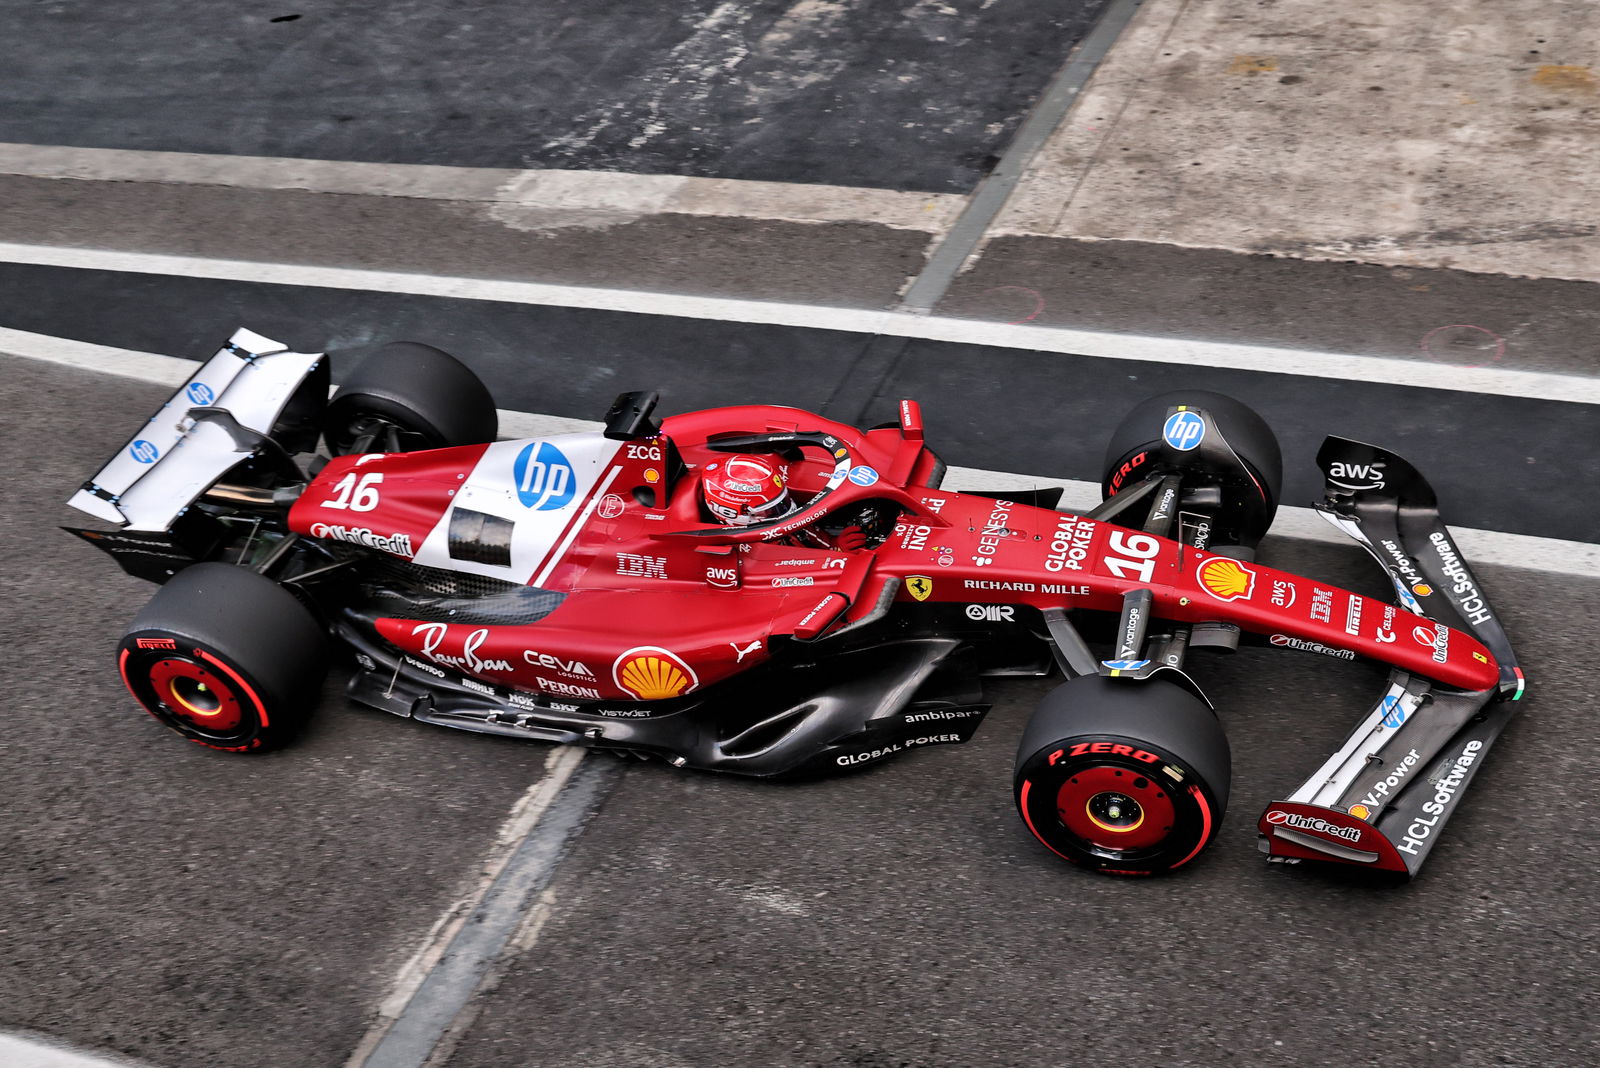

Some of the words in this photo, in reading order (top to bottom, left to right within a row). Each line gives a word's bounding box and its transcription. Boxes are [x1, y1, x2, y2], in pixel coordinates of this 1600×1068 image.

[187, 382, 213, 405] hp
[1165, 411, 1203, 450] hp
[131, 440, 158, 463] hp
[515, 442, 575, 511] hp
[849, 466, 878, 486] hp
[1329, 461, 1384, 481] aws
[321, 472, 384, 512] 16
[710, 501, 738, 519] 16
[782, 507, 828, 532] TECHNOLOGY
[977, 499, 1014, 555] GENESYS
[330, 525, 412, 558] UniCredit
[1044, 514, 1079, 572] GLOBAL
[1064, 520, 1096, 571] POKER
[616, 552, 668, 579] IBM
[1103, 530, 1160, 583] 16
[1381, 539, 1423, 585] V-Power
[706, 567, 736, 581] aws
[780, 576, 814, 588] UniCredit
[964, 579, 1035, 593] RICHARD
[1041, 583, 1090, 596] MILLE
[1271, 580, 1288, 606] aws
[1310, 587, 1333, 624] IBM
[1345, 594, 1363, 636] PIRELLI
[1383, 605, 1393, 631] CELSIUS
[1125, 608, 1140, 646] vantage
[136, 638, 176, 650] PIRELLI
[1286, 636, 1355, 662] UniCredit
[1432, 623, 1449, 664] UniCredit
[461, 678, 495, 696] MAHLE
[535, 676, 601, 700] PERONI
[558, 671, 598, 683] LOGISTICS
[508, 694, 536, 707] NGK
[836, 744, 902, 767] GLOBAL
[904, 733, 960, 747] POKER
[1047, 749, 1065, 766] P
[1069, 742, 1161, 764] ZERO
[1360, 748, 1421, 808] V-Power
[1396, 739, 1483, 855] HCLSoftware
[1286, 813, 1361, 843] UniCredit
